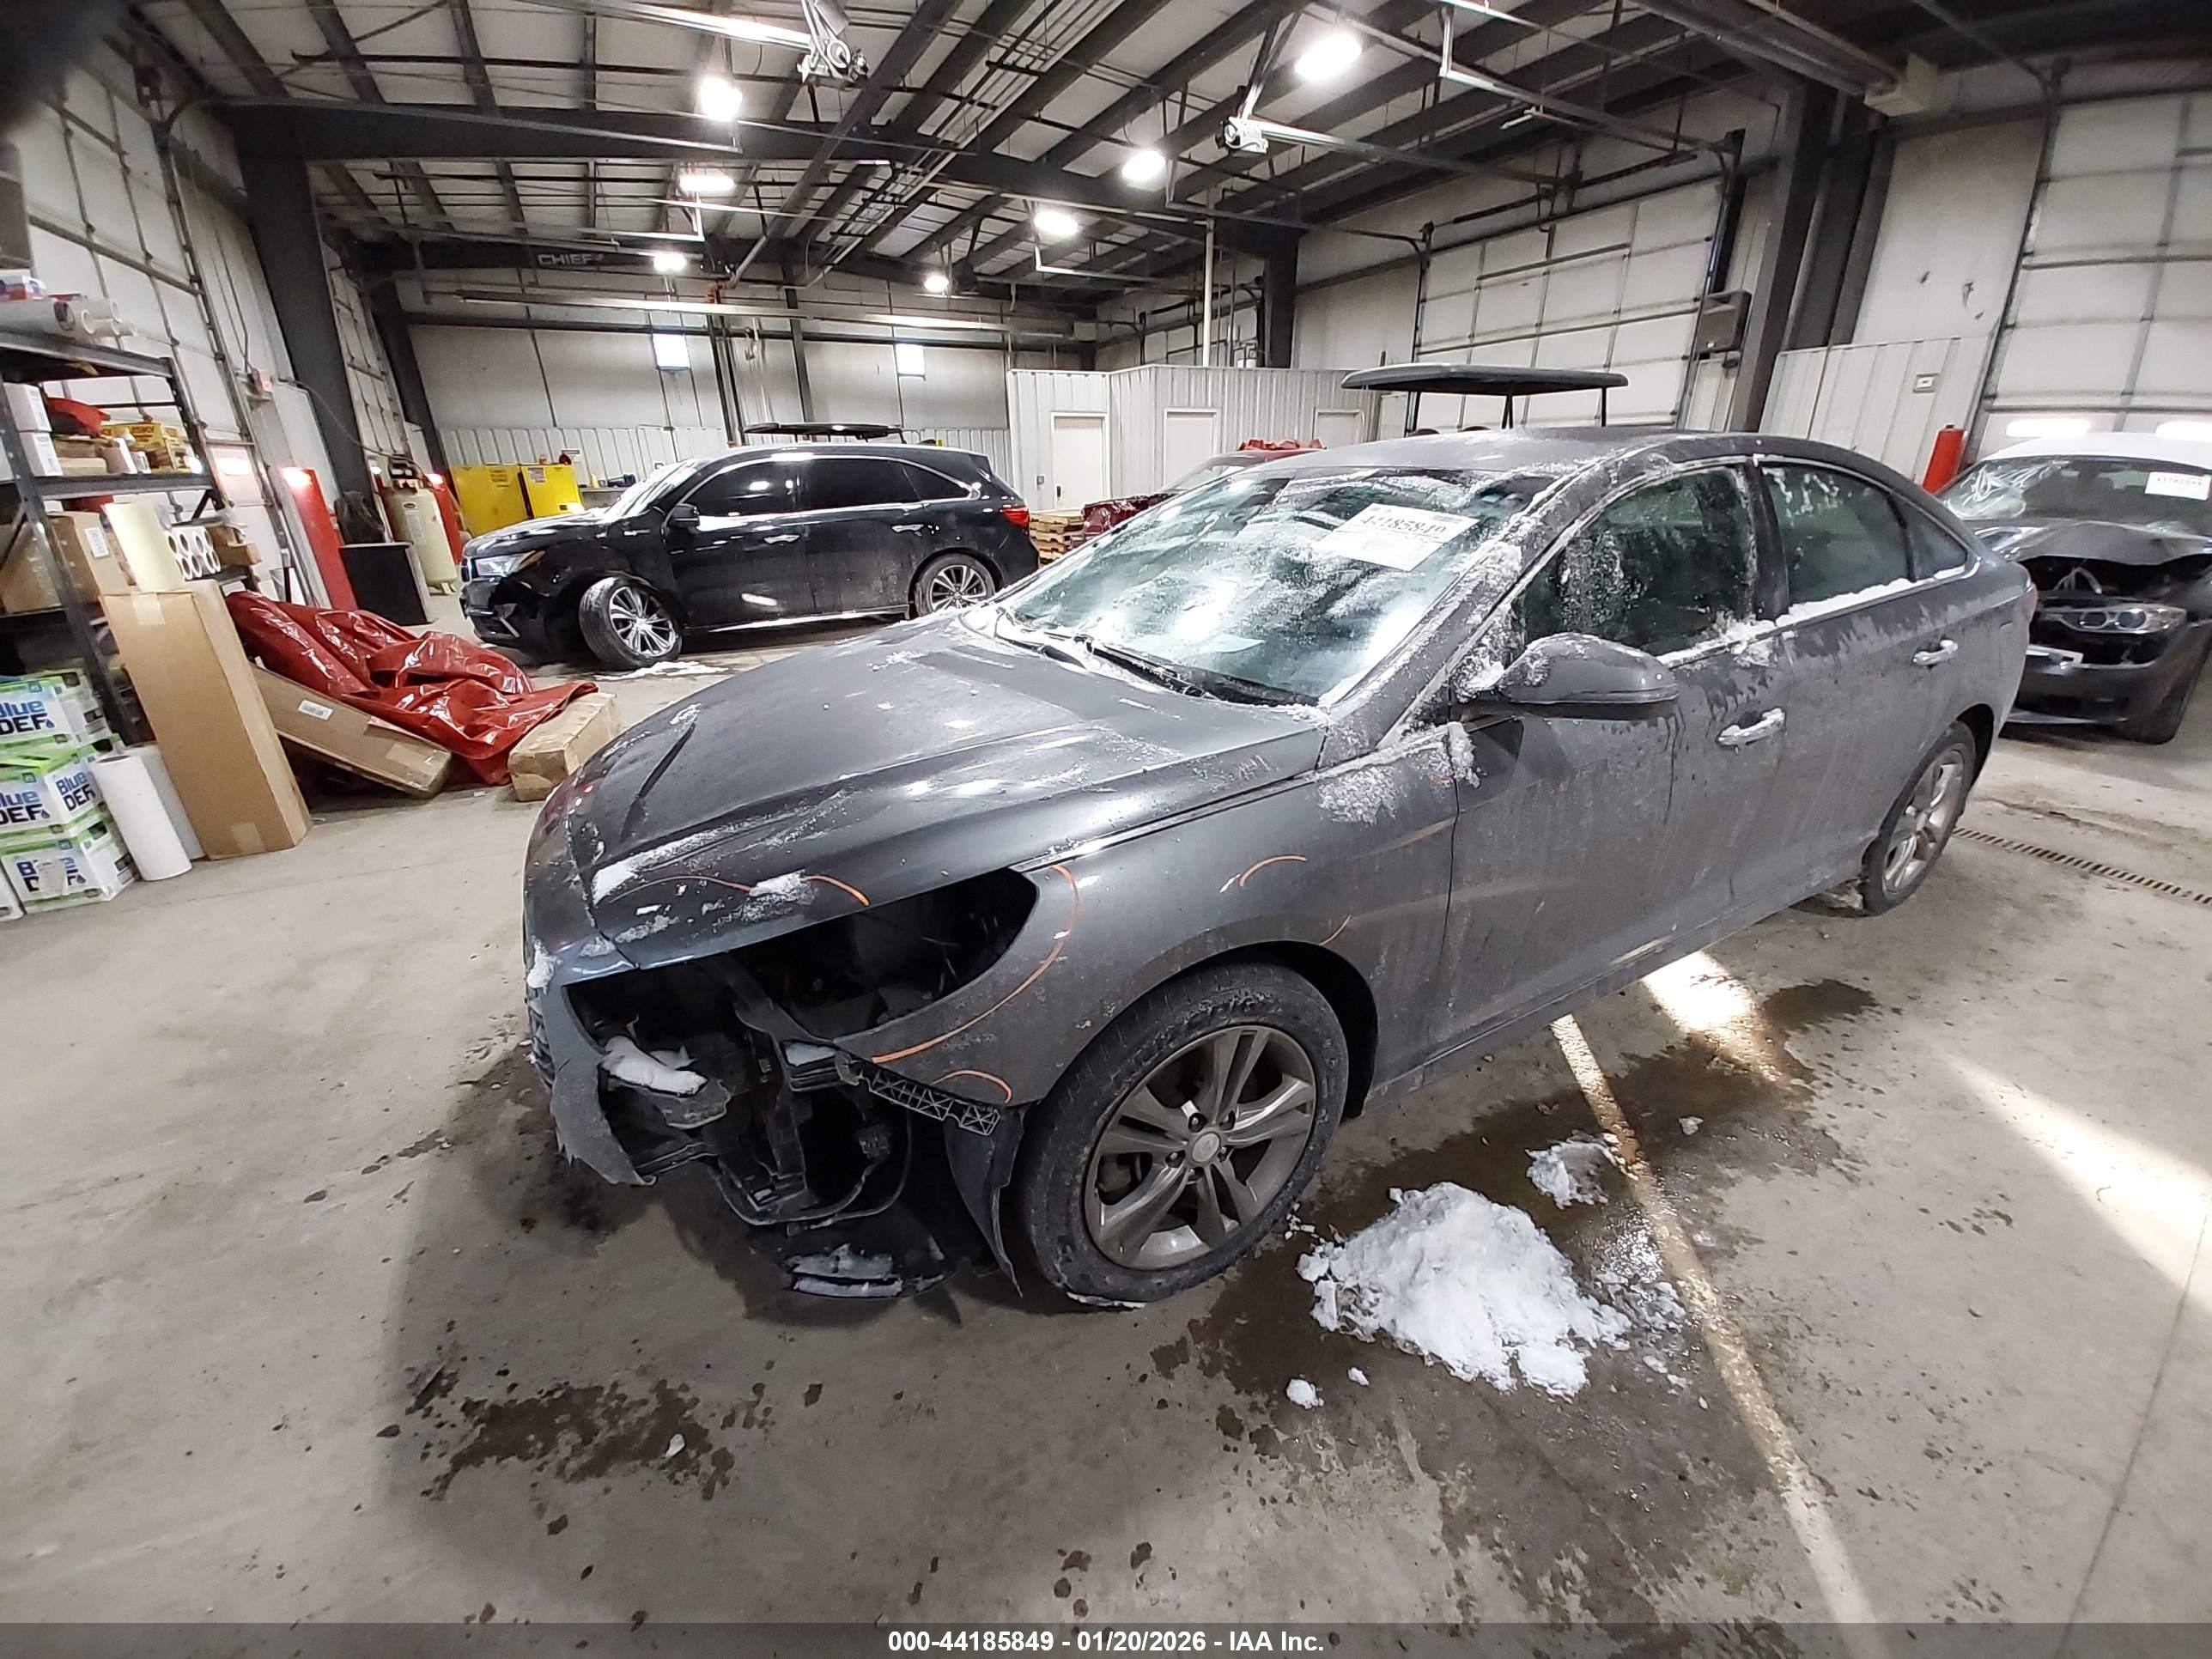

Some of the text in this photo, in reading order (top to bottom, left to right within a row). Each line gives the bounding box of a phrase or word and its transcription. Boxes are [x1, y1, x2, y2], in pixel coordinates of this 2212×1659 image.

[537, 252, 592, 266] CHIEF
[55, 772, 88, 796] Blue
[0, 790, 41, 809] lue
